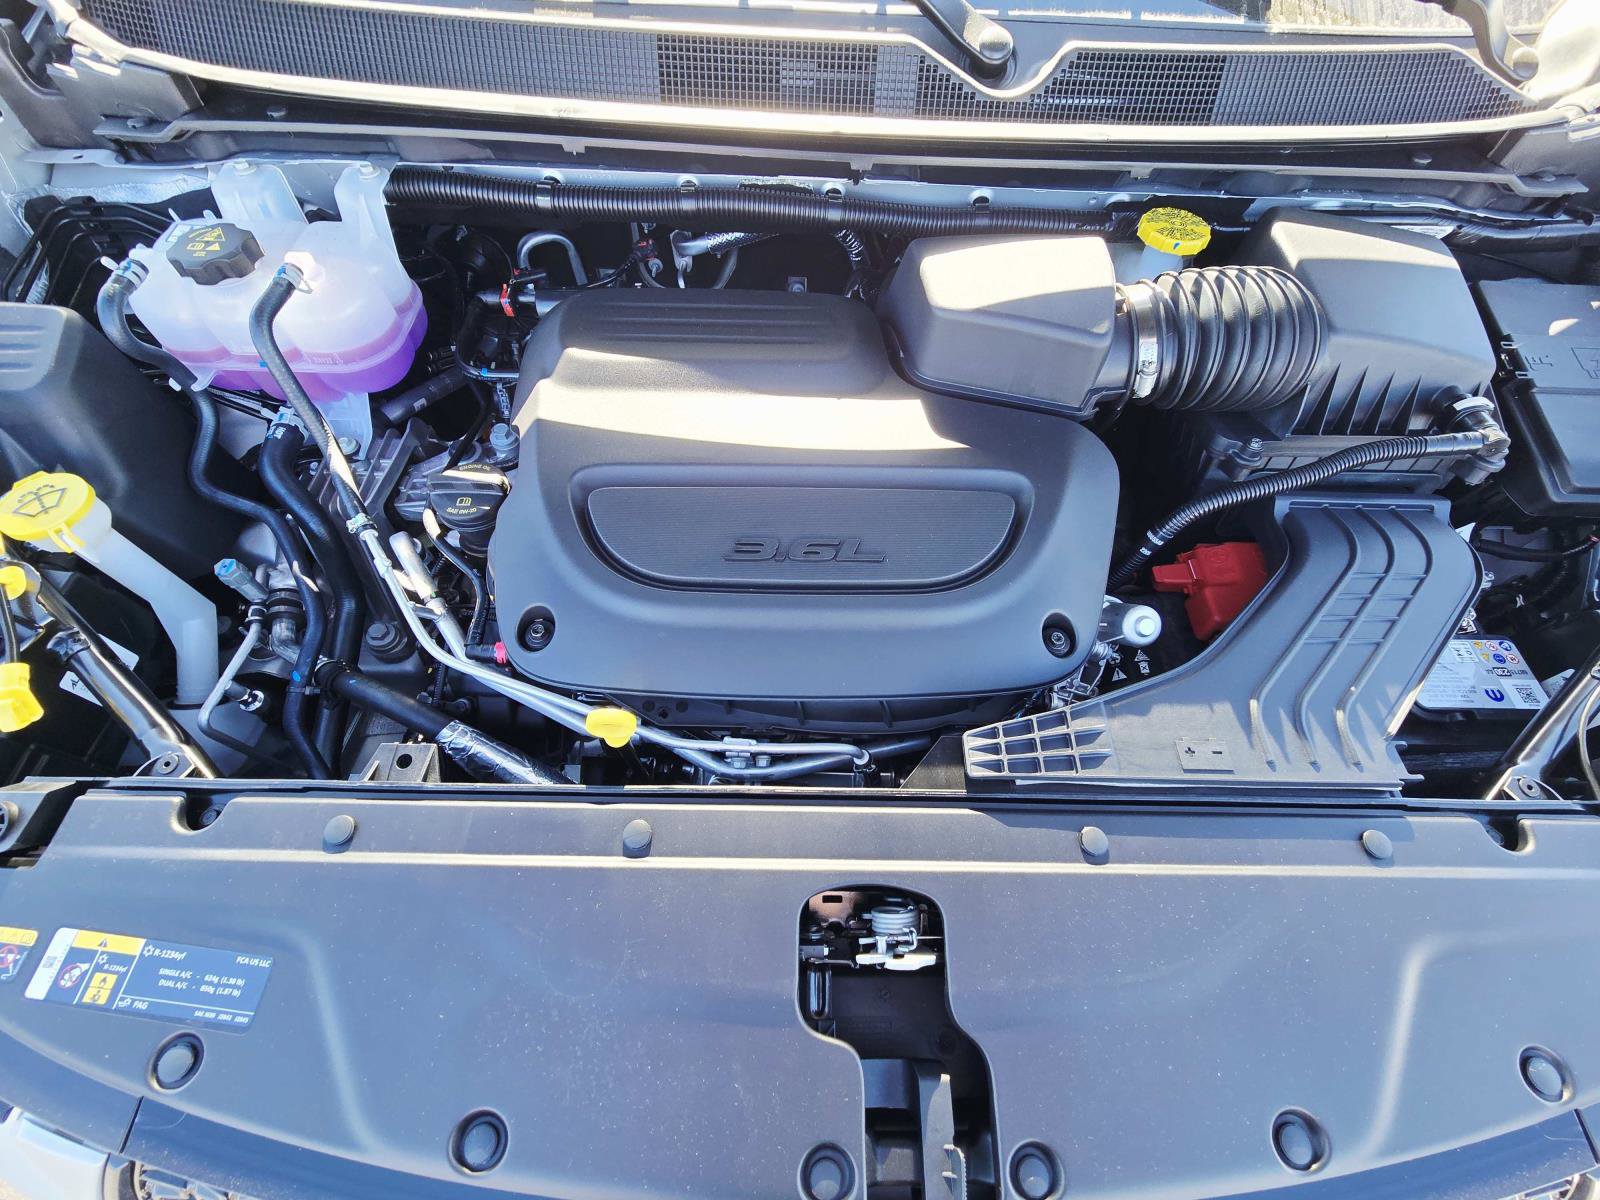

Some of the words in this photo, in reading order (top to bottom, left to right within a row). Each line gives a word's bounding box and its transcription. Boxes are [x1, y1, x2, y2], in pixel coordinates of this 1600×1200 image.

[722, 537, 888, 562] 3.6L
[153, 947, 187, 961] R-1234yf
[235, 955, 249, 966] FCA
[249, 957, 259, 967] US
[258, 959, 272, 968] LLC
[159, 968, 180, 977] SINGLE
[180, 969, 194, 980] A/C
[158, 978, 175, 987] DUAL
[175, 980, 188, 991] A/C
[132, 1000, 149, 1010] PAG
